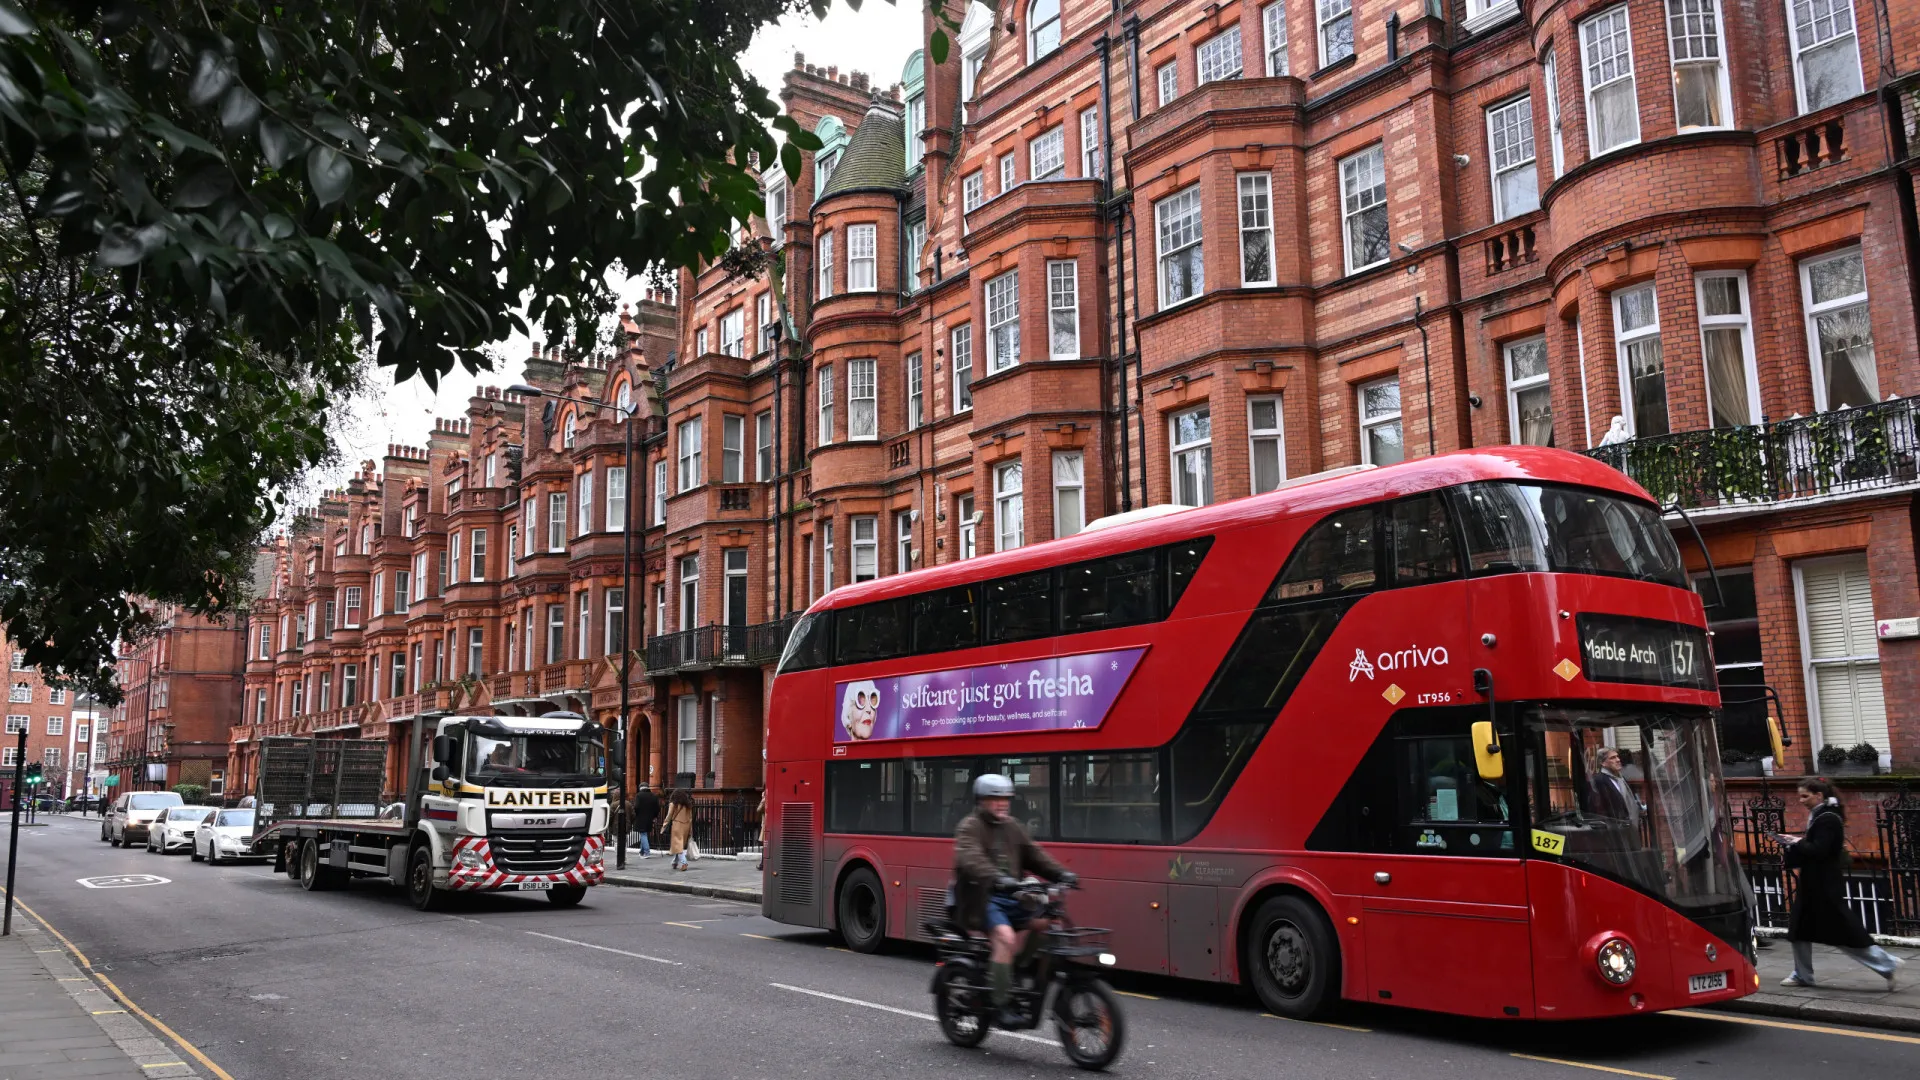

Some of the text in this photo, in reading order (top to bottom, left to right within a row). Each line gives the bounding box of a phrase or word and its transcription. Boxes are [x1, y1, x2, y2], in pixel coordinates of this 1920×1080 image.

[1377, 644, 1449, 671] arriva
[1585, 639, 1656, 665] Marble Arch
[1671, 640, 1694, 675] 137
[902, 669, 1094, 711] selfcare just got fresha
[1418, 692, 1451, 704] LT956
[922, 709, 1067, 727] The go-to booking app for beauty, wellness, and selfcare
[488, 790, 591, 806] LANTERN
[1535, 836, 1560, 850] 187
[1692, 974, 1722, 990] LTZ 2156
